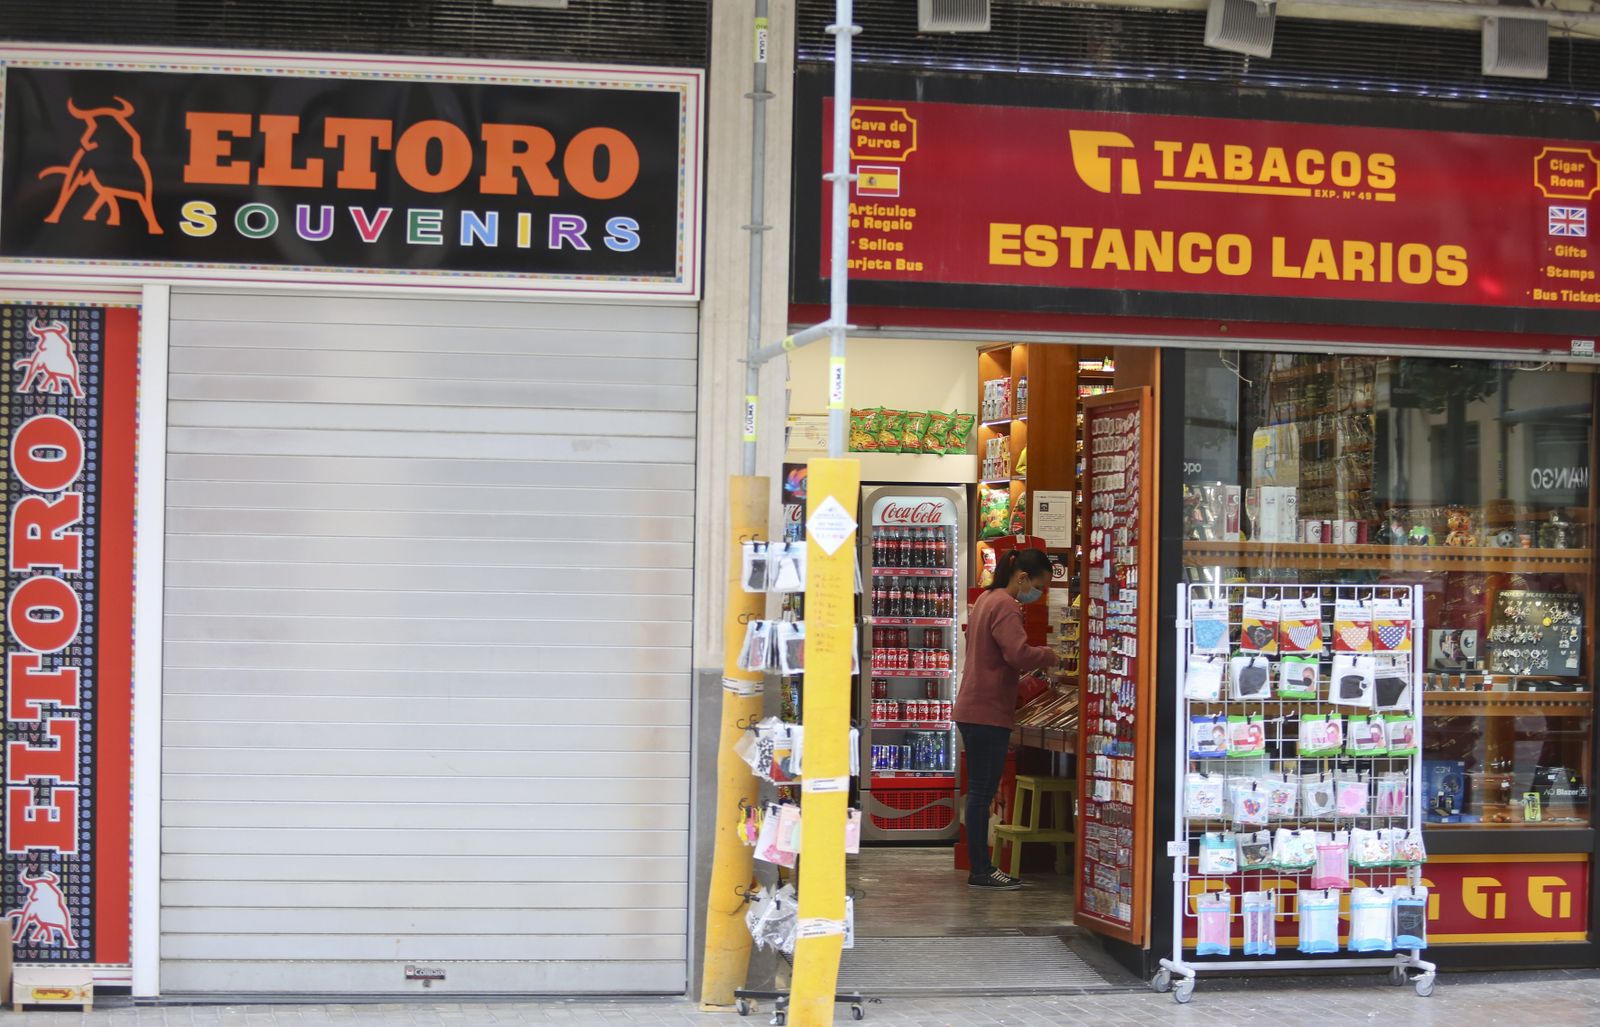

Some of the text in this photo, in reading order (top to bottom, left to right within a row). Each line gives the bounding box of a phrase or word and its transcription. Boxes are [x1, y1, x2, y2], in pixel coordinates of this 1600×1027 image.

[851, 118, 908, 133] Cava de
[857, 135, 901, 150] Puros
[184, 111, 640, 200] ELTORO
[1154, 140, 1397, 189] TABACOS
[1550, 159, 1585, 173] Cigar
[1550, 175, 1585, 189] Room
[1314, 188, 1340, 199] EXP.
[848, 203, 917, 218] Artículos
[179, 200, 641, 252] SOUVENIRS
[863, 217, 913, 232] Regalo
[858, 238, 904, 252] Sellos
[1555, 244, 1588, 259] Gifts
[988, 222, 1469, 286] ESTANCO LARIOS
[847, 258, 924, 272] arjeta Bus
[1546, 265, 1596, 282] Stamps
[1533, 288, 1558, 301] Bus
[747, 403, 755, 425] ULMA
[881, 501, 945, 524] Coca-Cola
[7, 413, 84, 855] ELTORO
[1556, 788, 1579, 796] Blazer
